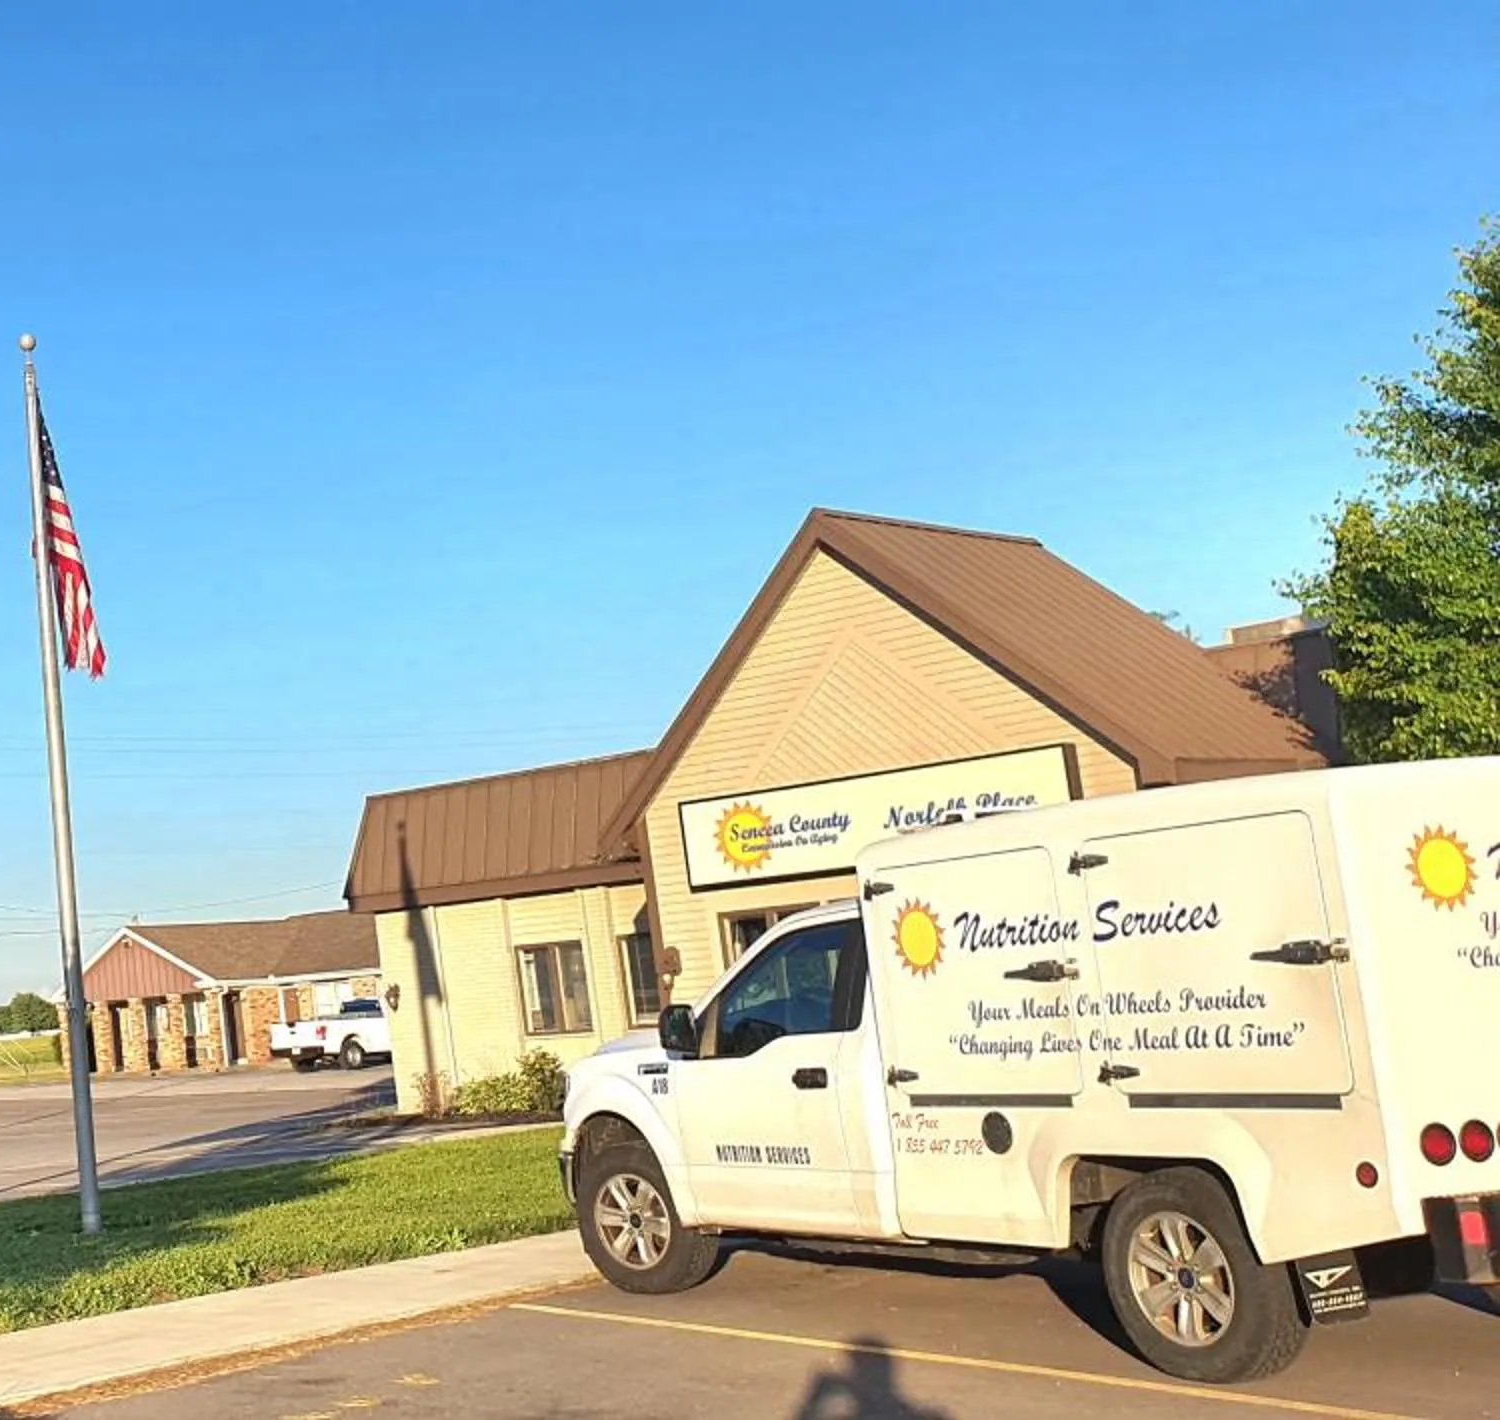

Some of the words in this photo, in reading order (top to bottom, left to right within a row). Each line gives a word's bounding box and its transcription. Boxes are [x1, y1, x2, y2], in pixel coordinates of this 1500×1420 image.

[729, 823, 785, 842] Seneca
[789, 811, 851, 833] County
[953, 911, 1080, 953] Nutrition
[1092, 900, 1221, 943] Services
[968, 999, 1011, 1029] Your
[1016, 996, 1070, 1021] Meals
[1076, 993, 1101, 1017] On
[1105, 990, 1171, 1016] Wheels
[1179, 985, 1267, 1013] Provider
[1040, 1031, 1083, 1053] Lives
[1089, 1028, 1122, 1051] One
[1128, 1027, 1180, 1051] Meal
[1185, 1024, 1210, 1049] At
[1215, 1023, 1233, 1048] A
[891, 1112, 912, 1129] Toll
[916, 1113, 939, 1132] Free
[716, 1144, 762, 1163] NUTRITION
[765, 1145, 811, 1165] SERVICES
[905, 1137, 926, 1154] 855
